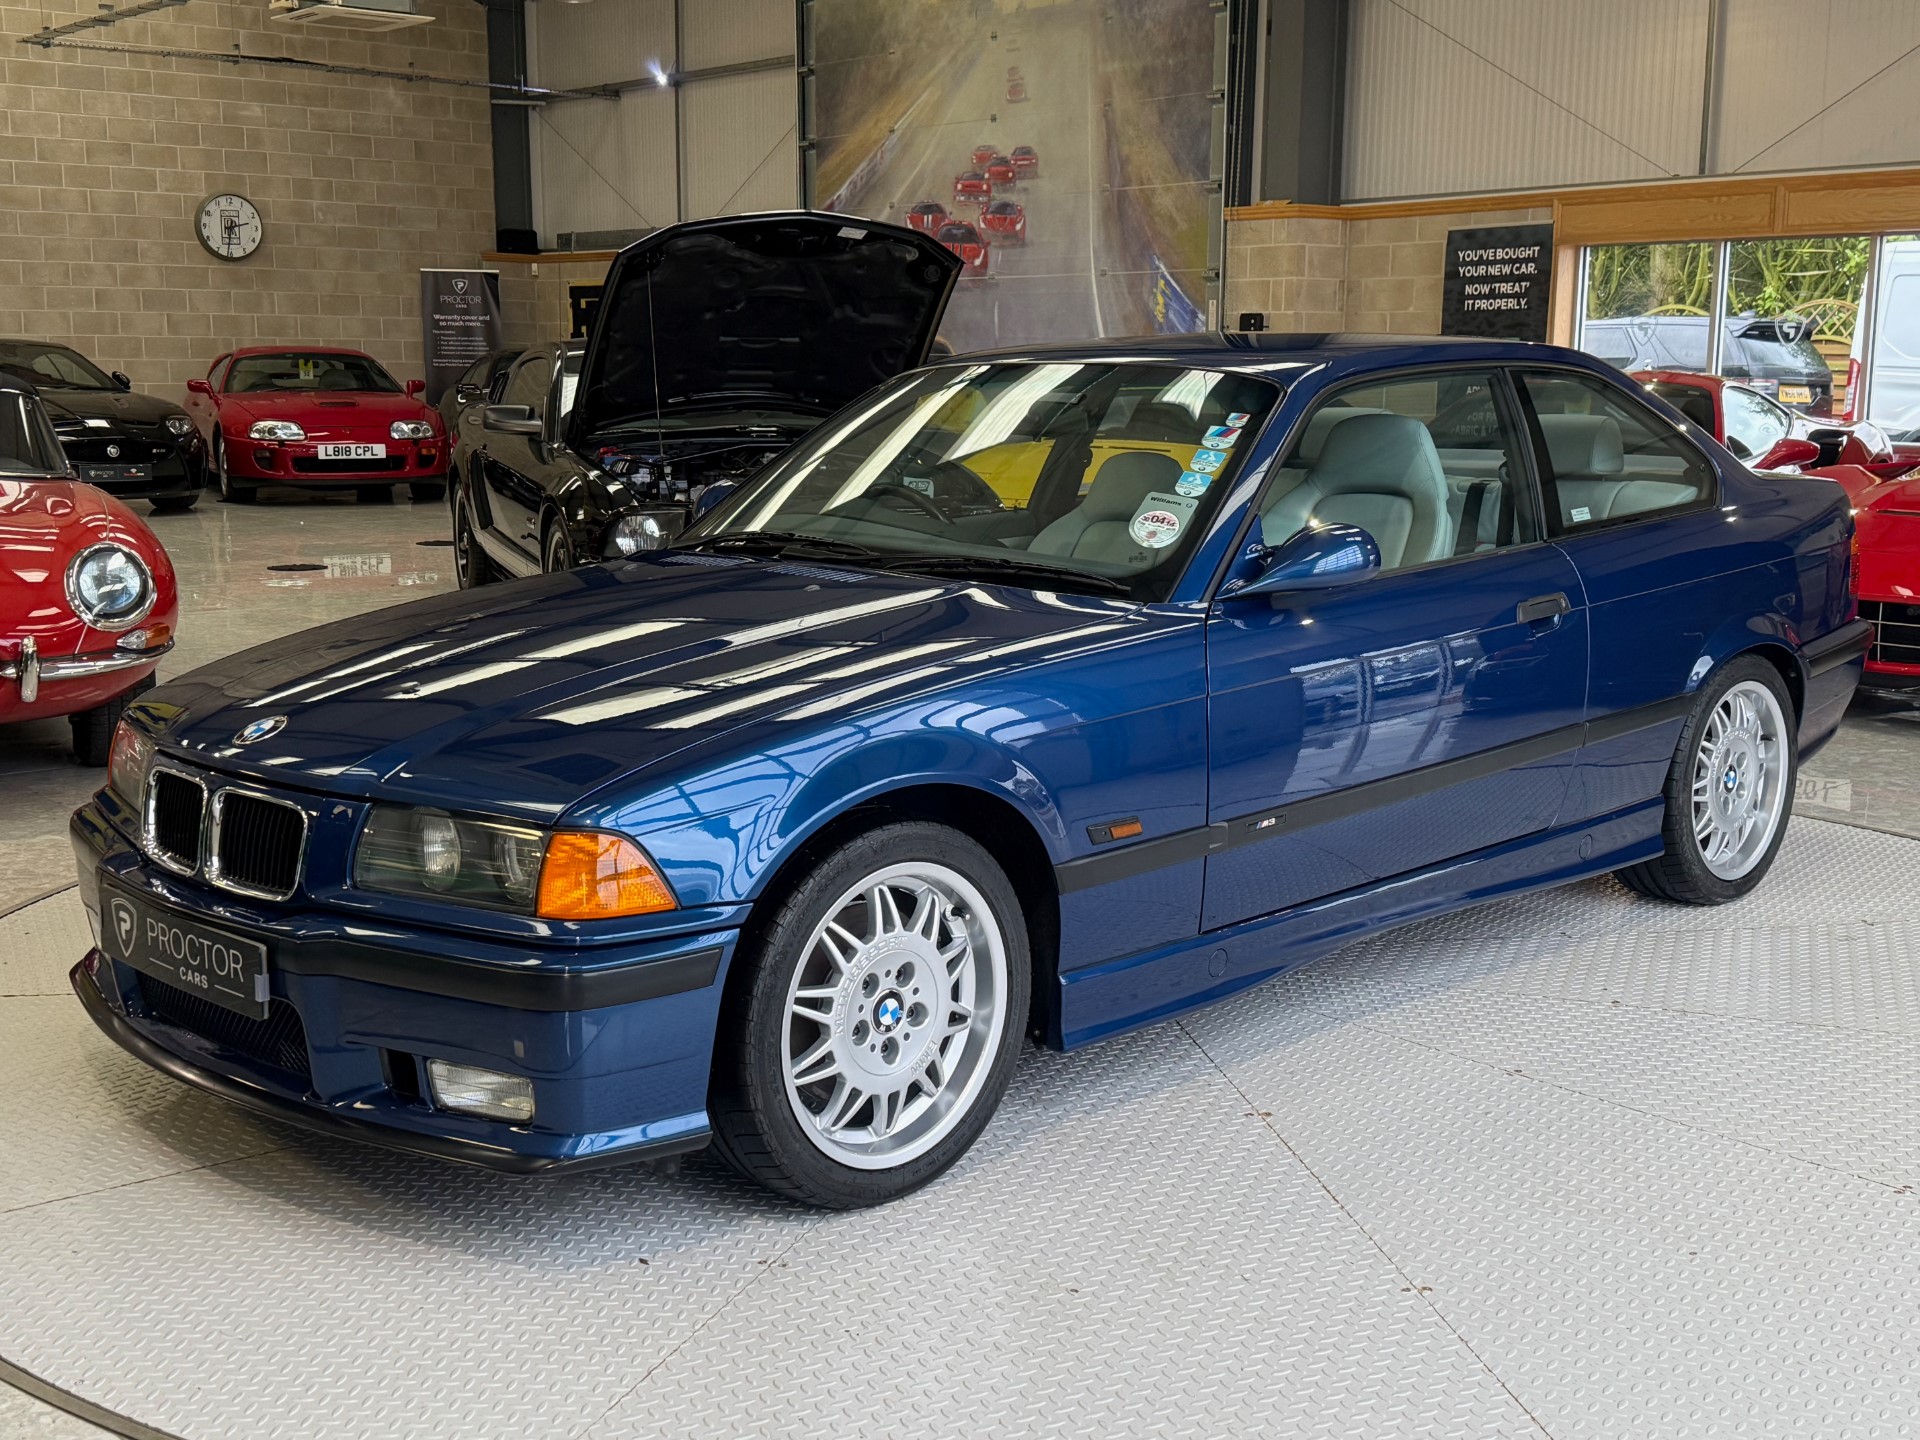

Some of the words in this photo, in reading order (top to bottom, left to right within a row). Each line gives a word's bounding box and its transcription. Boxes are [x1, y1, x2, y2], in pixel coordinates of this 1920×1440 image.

[226, 197, 233, 205] 12
[1496, 246, 1540, 260] BOUGHT
[1458, 265, 1486, 277] YOUR
[1487, 263, 1512, 276] NEW
[1513, 262, 1538, 275] CAR.
[1465, 283, 1491, 295] NOW
[440, 295, 482, 304] PROCTOR
[1464, 299, 1474, 311] IT
[1474, 297, 1528, 311] PROPERLY.
[324, 445, 352, 457] L818
[354, 445, 378, 457] CPL
[1150, 496, 1182, 507] Williams
[1151, 515, 1167, 525] 04
[147, 917, 244, 982] PROCTOR
[179, 966, 208, 989] CARS
